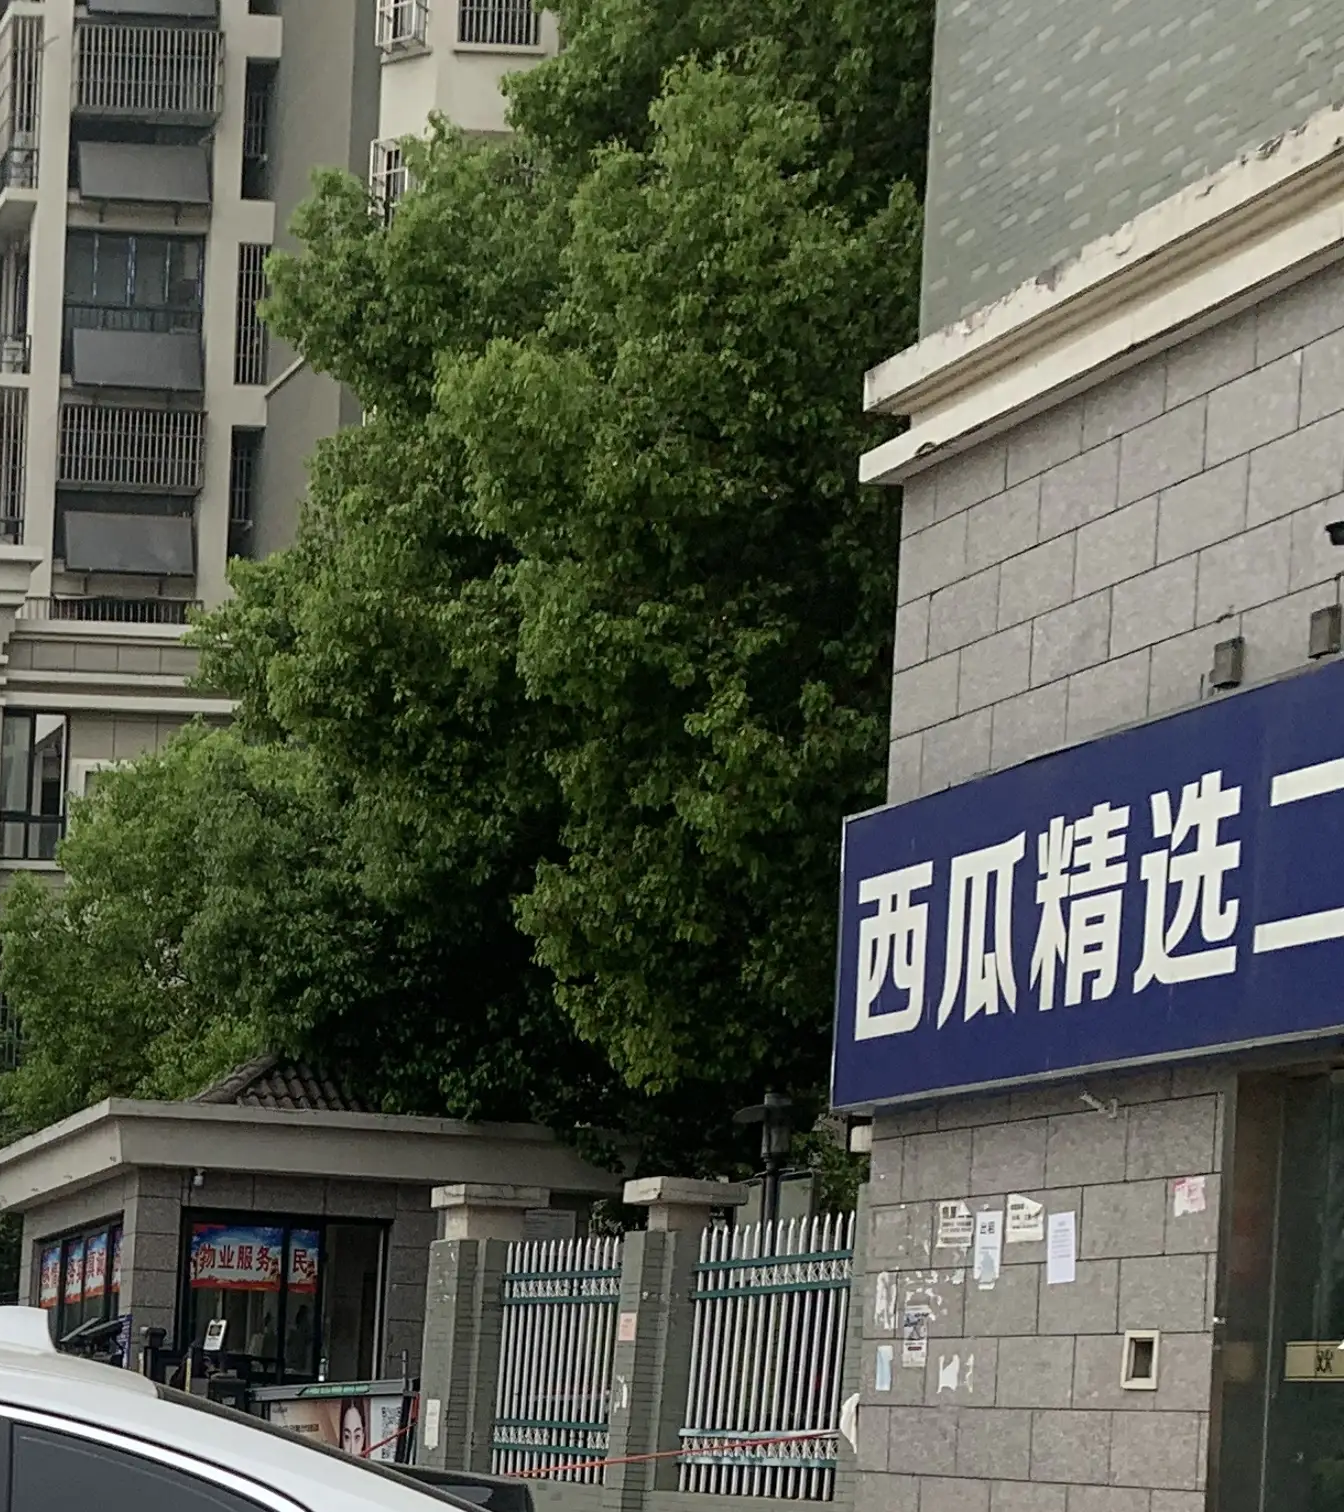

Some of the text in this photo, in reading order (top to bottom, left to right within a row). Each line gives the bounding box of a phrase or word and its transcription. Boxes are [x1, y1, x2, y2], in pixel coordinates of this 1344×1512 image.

[854, 758, 1344, 1041] 西瓜精选二
[196, 1243, 271, 1273] 物业服务
